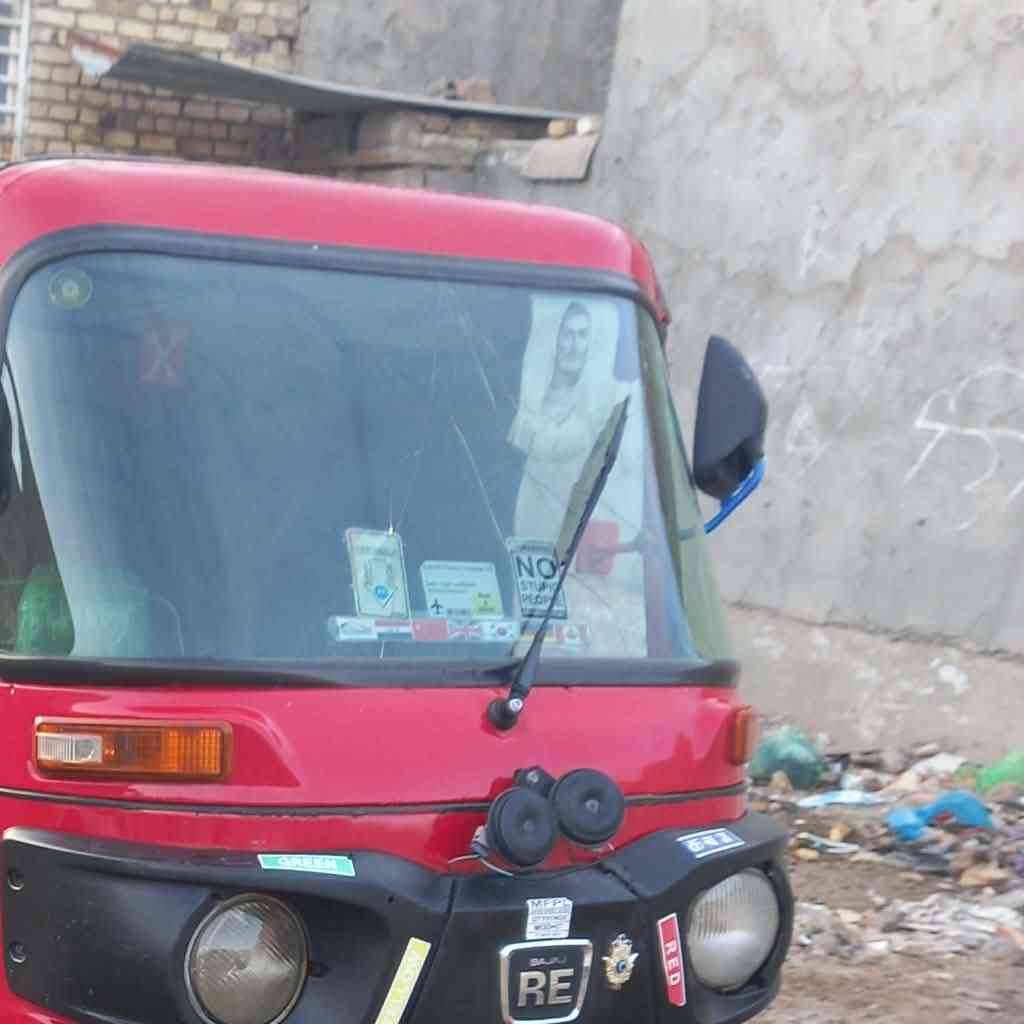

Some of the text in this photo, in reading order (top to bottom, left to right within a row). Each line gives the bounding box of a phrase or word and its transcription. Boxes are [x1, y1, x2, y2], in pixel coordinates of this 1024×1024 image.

[515, 556, 556, 580] NO
[664, 938, 681, 986] RED
[517, 968, 574, 1007] RE
